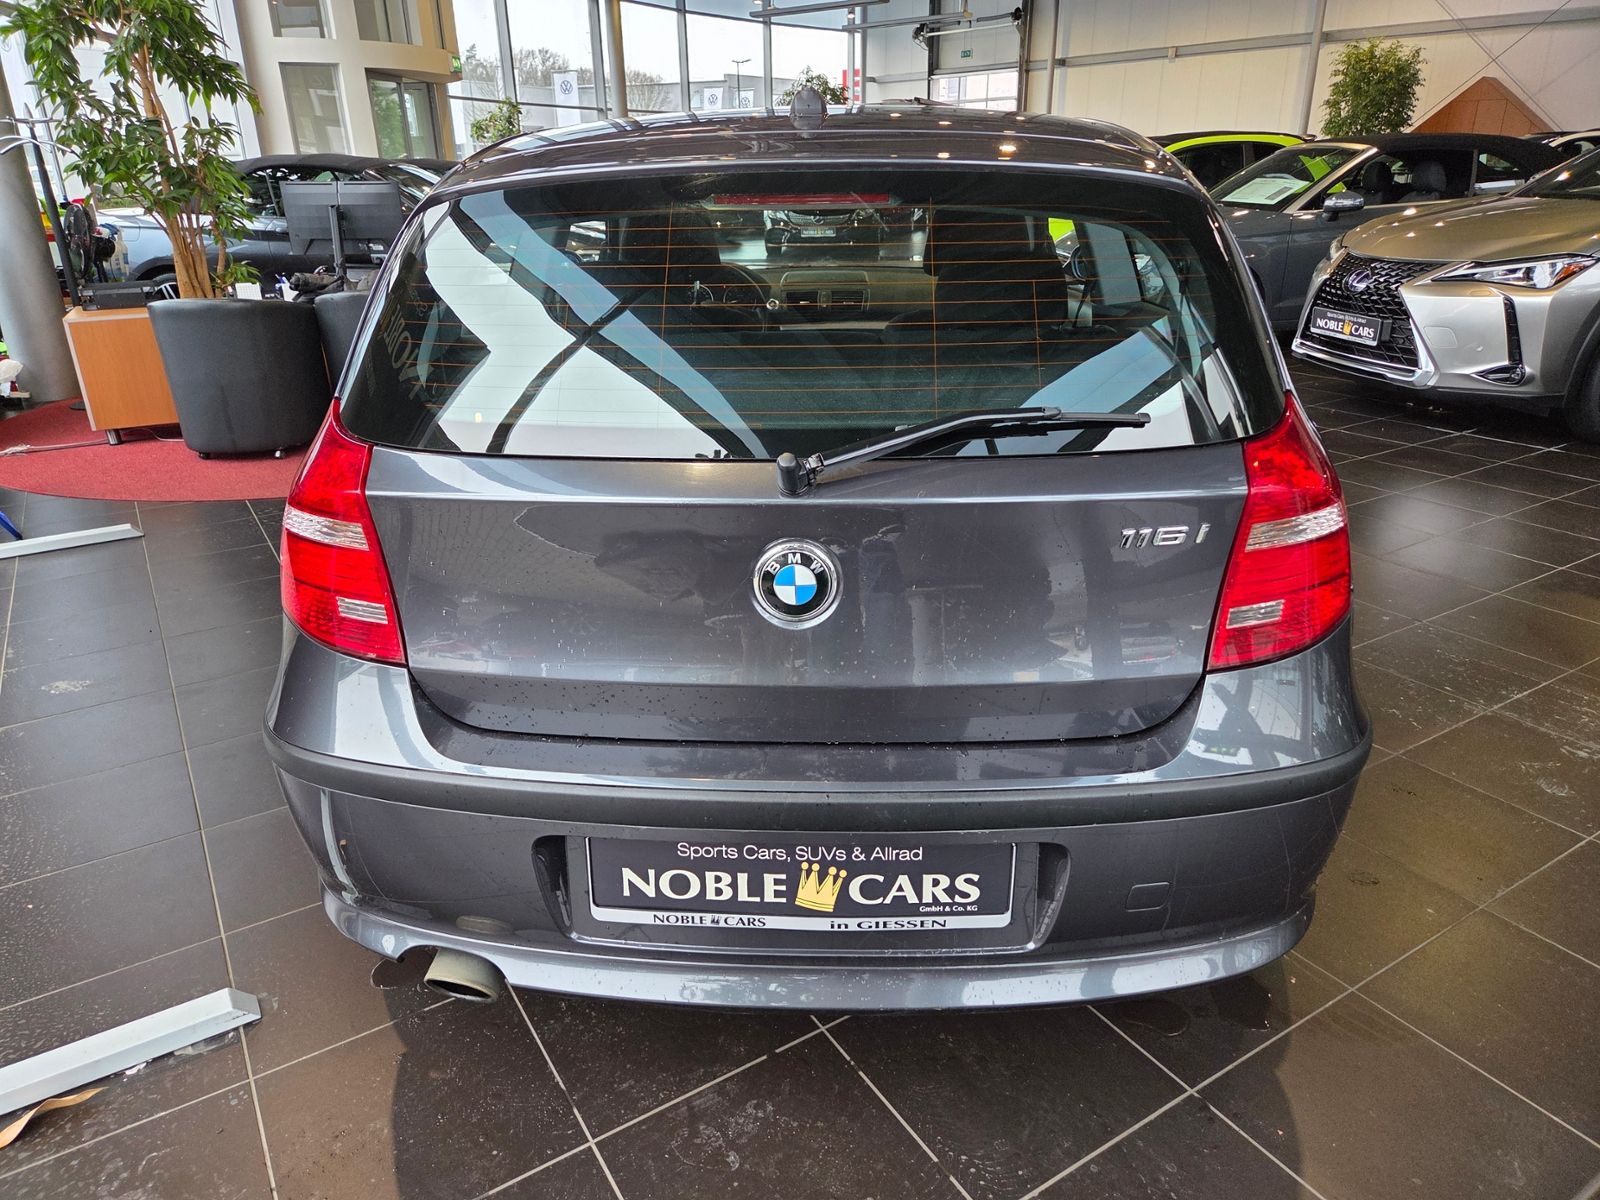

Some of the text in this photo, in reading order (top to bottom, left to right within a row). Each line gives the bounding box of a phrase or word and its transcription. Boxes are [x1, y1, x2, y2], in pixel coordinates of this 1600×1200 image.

[1316, 318, 1344, 332] NOBLE
[1351, 325, 1375, 338] CARS
[764, 552, 824, 576] BMW
[677, 842, 923, 863] Sports Cars, SUVs & Allrad
[621, 867, 981, 905] NOBLE CARS
[966, 904, 978, 912] KG
[653, 913, 947, 930] NOBLE CARS in GIESSEN
